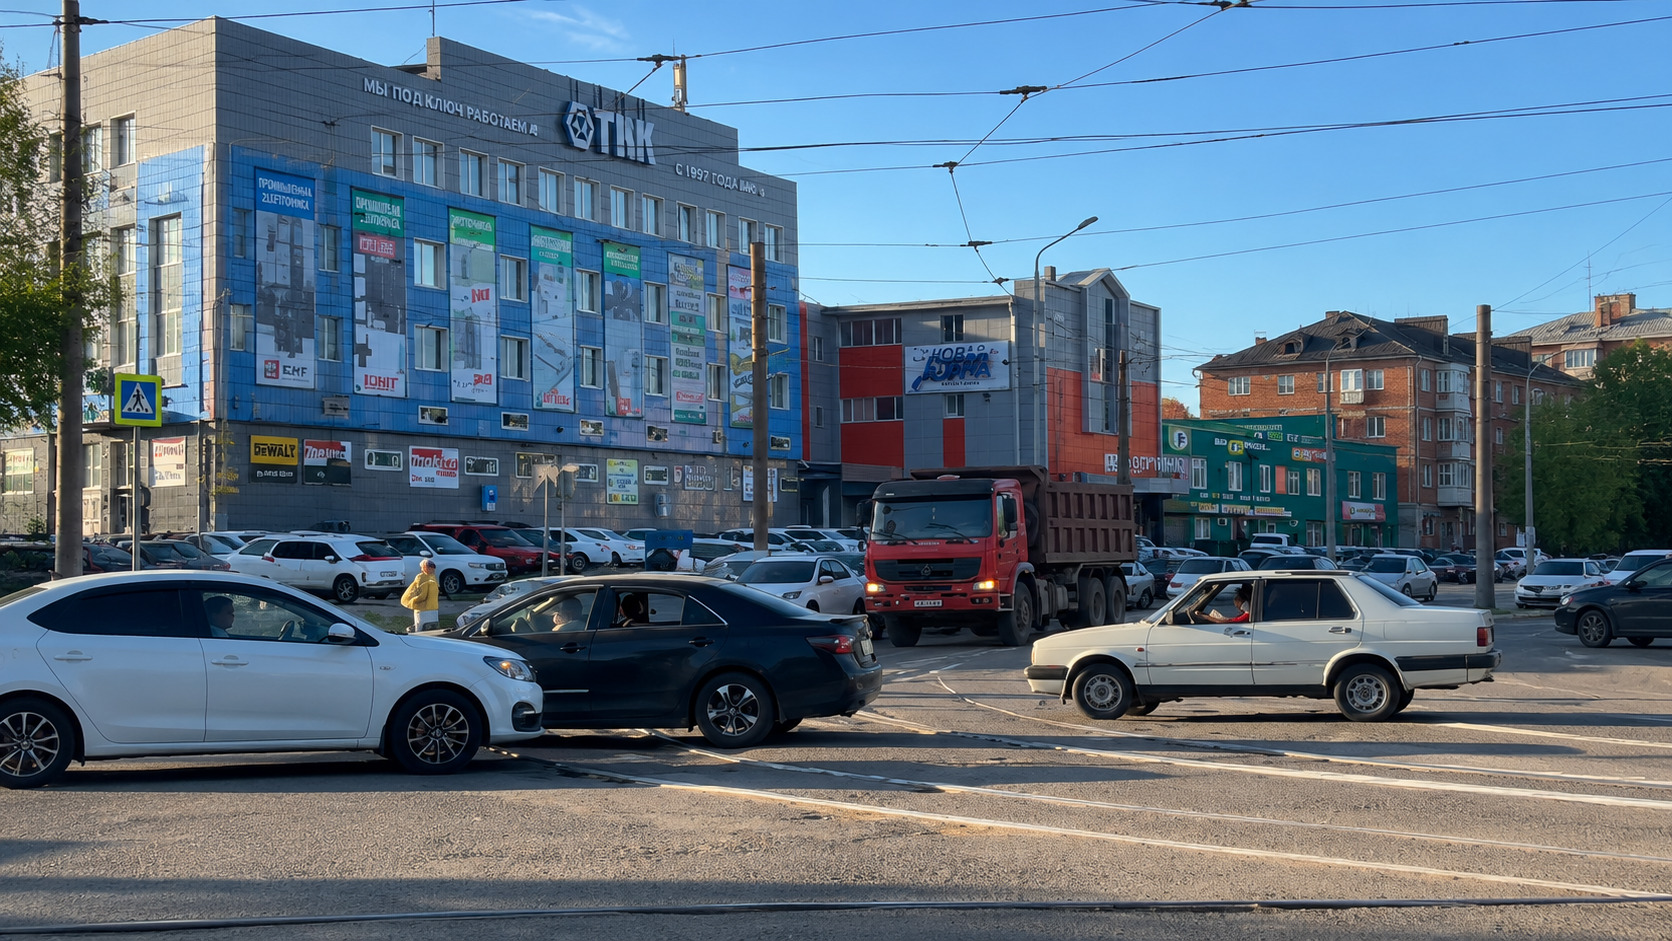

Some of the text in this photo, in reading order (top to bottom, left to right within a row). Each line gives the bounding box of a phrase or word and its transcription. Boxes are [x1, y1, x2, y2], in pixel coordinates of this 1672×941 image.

[364, 77, 388, 97] МЫ
[392, 86, 422, 107] ПОД
[425, 93, 464, 117] КЛЮЧ
[467, 105, 528, 135] РАБОТАЕМ
[686, 164, 709, 182] 1997
[711, 171, 738, 191] ГОДА
